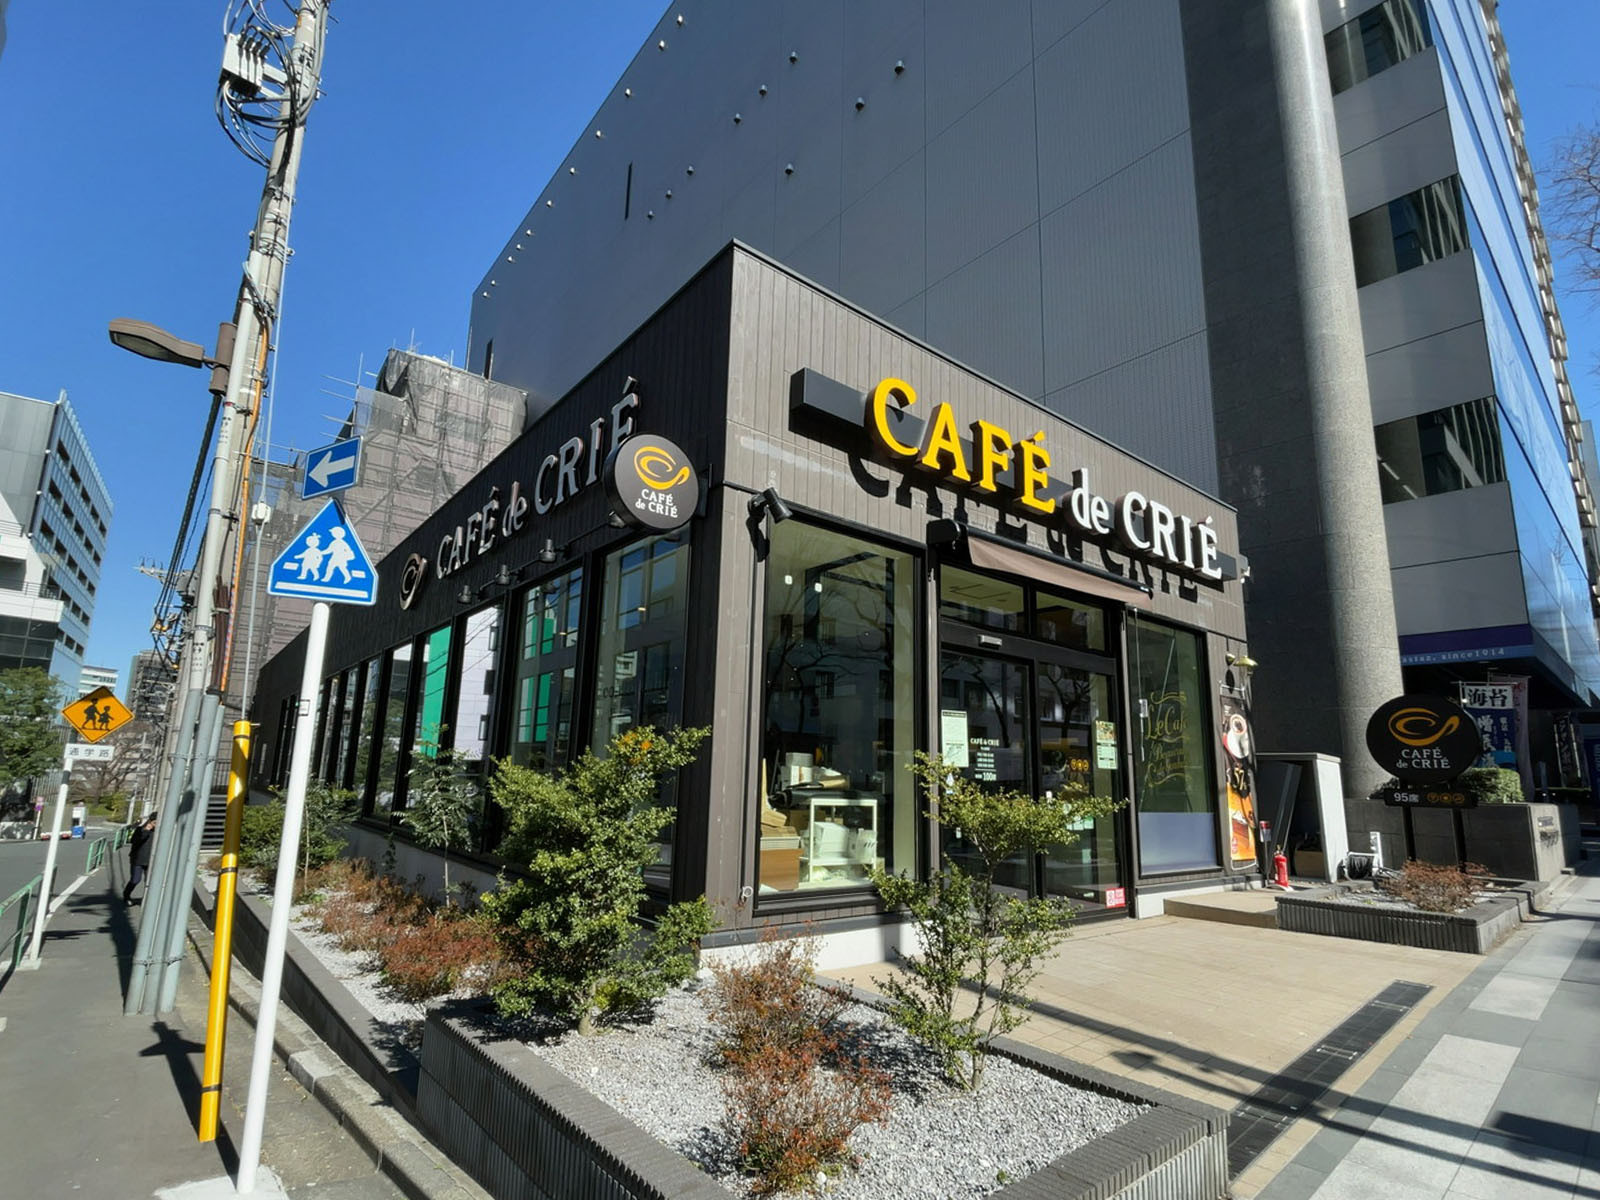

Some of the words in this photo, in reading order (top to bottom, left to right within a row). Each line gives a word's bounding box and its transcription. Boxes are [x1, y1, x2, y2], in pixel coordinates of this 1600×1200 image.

[436, 486, 499, 579] CAFÉ
[502, 480, 529, 537] de
[534, 375, 640, 516] CRIÉ
[871, 377, 1056, 514] CAFÉ
[1070, 467, 1110, 535] de
[1119, 490, 1223, 580] CRIÉ
[641, 488, 674, 506] CAFÉ
[635, 498, 646, 510] de
[648, 501, 679, 518] CRIÉ
[1467, 688, 1508, 707] 海苔
[69, 747, 110, 758] 通学路
[1401, 747, 1443, 759] CAFÉ
[1396, 759, 1409, 769] de
[1411, 757, 1451, 769] CRIÉ
